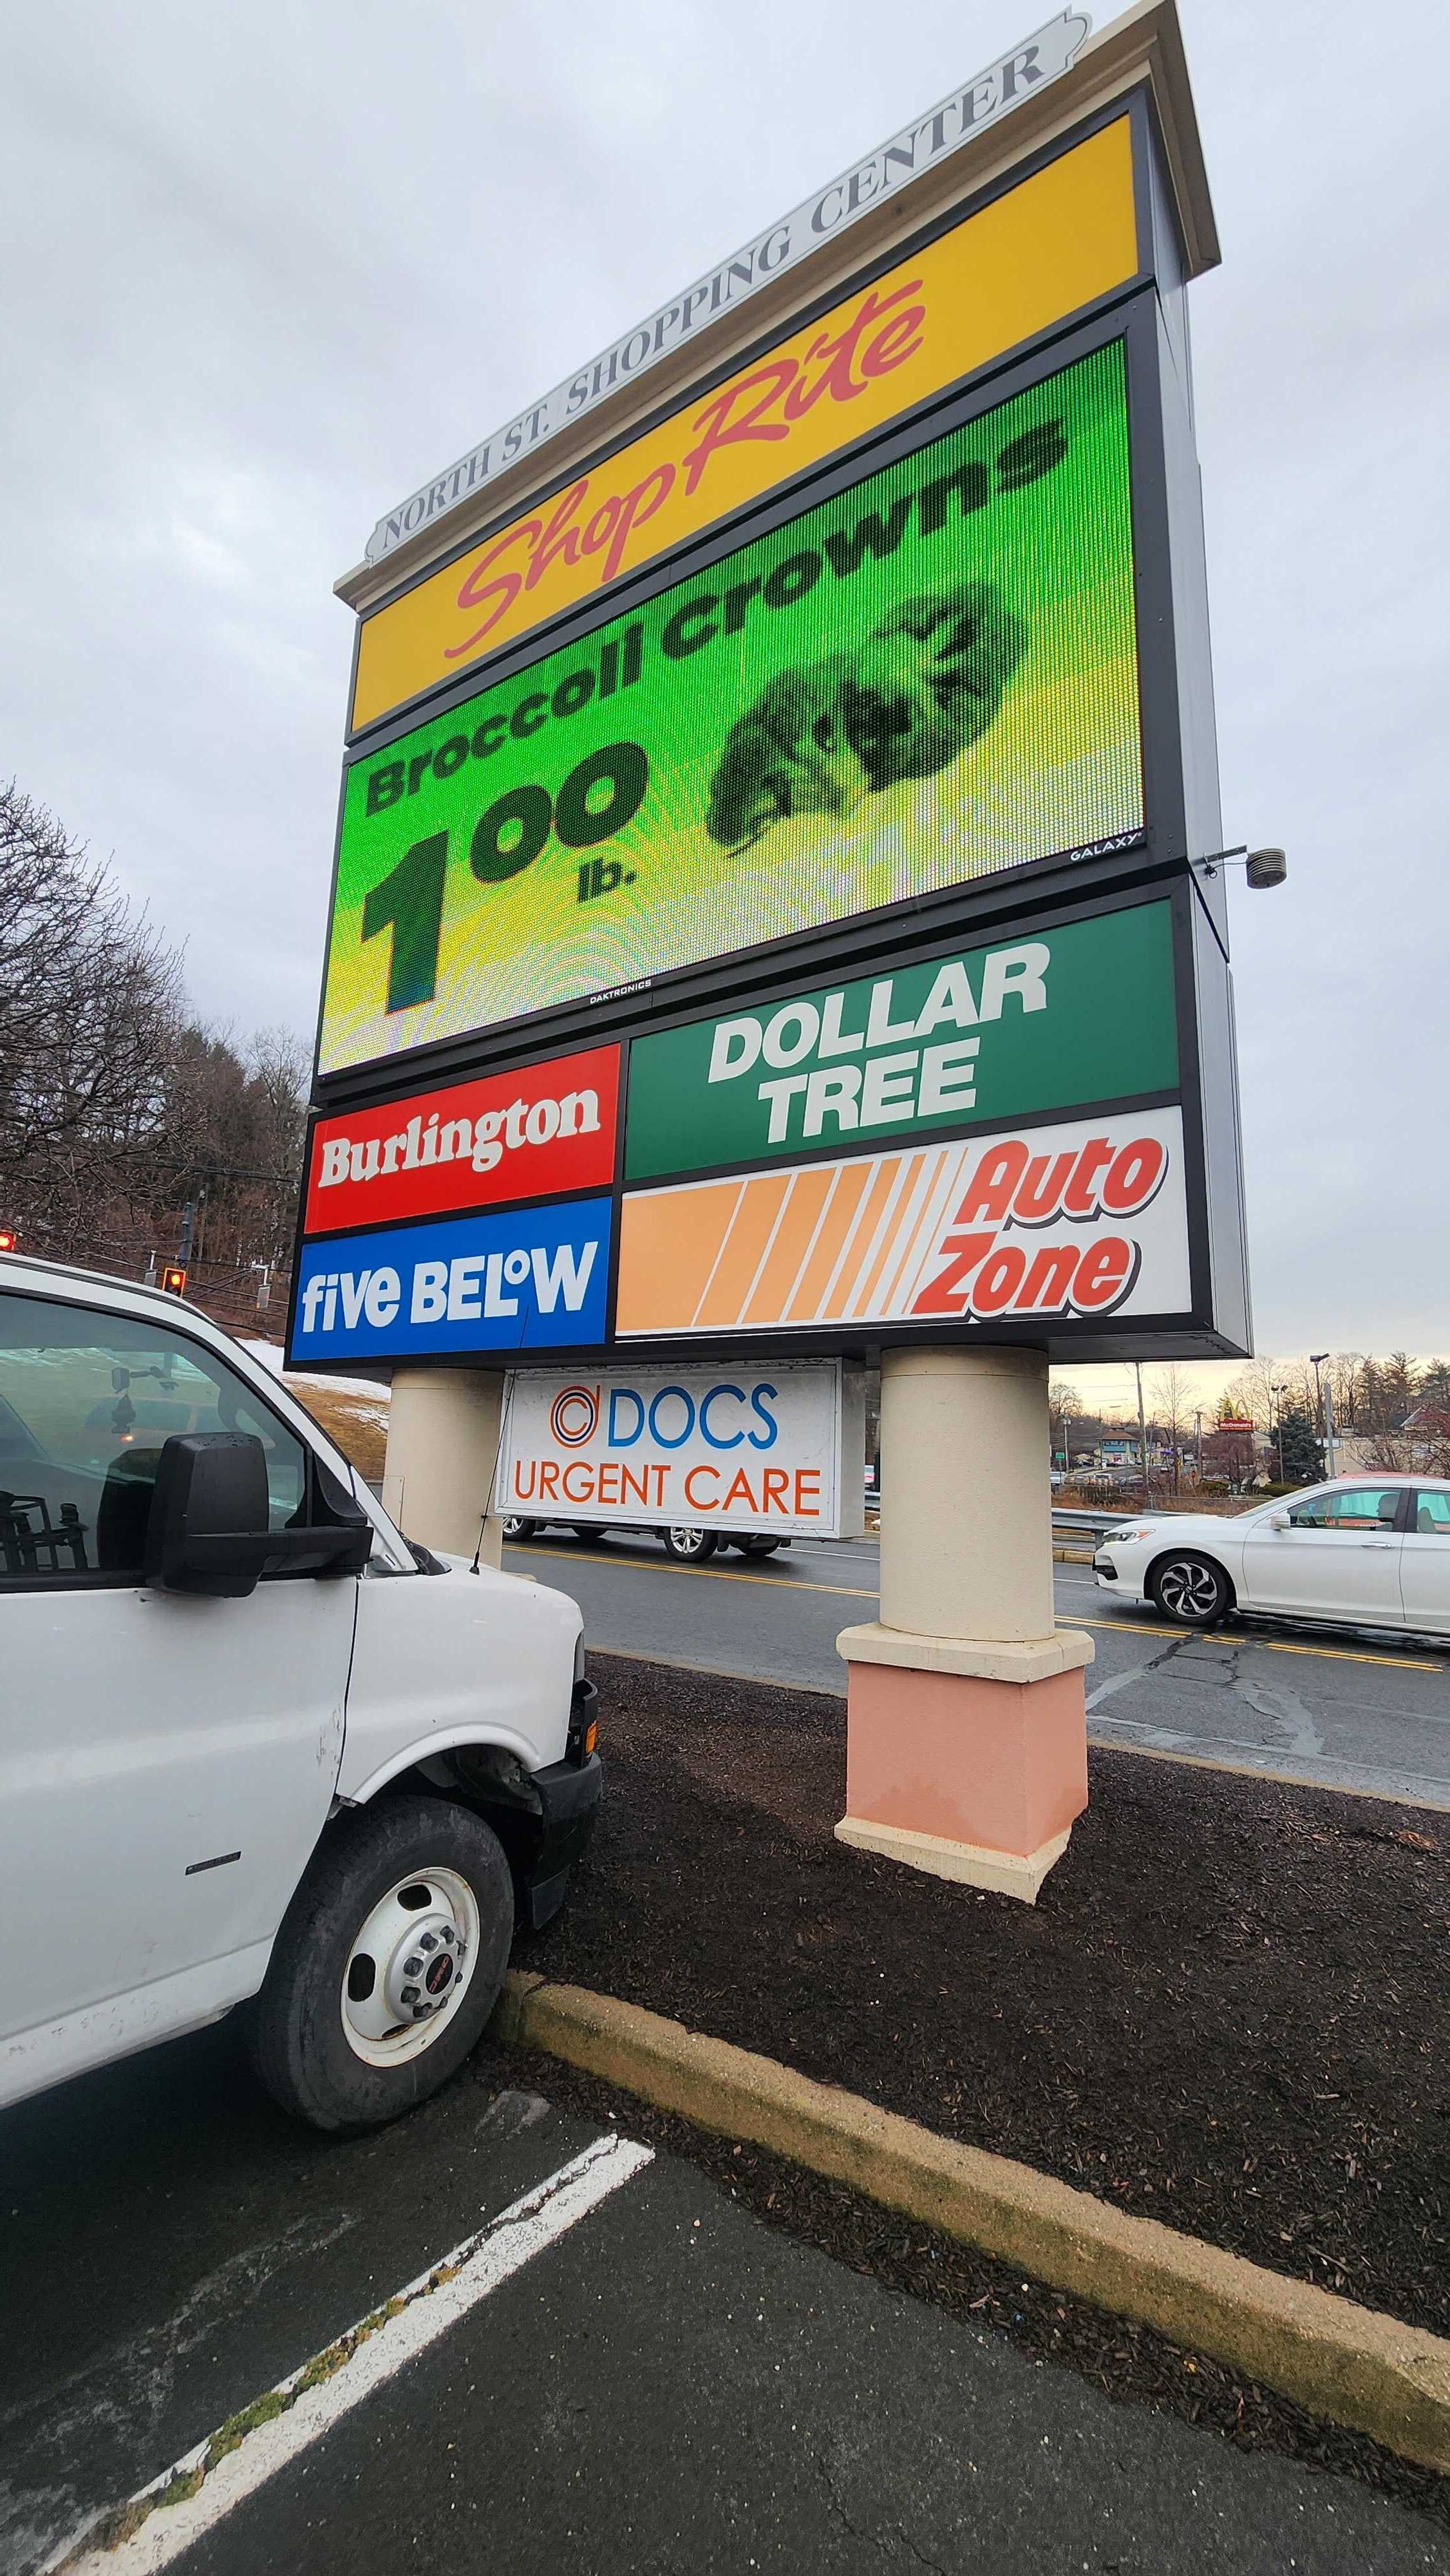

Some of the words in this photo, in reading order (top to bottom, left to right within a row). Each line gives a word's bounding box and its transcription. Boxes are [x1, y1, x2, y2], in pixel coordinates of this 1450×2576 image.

[383, 444, 491, 549] NORTH
[502, 404, 549, 461] ST.
[566, 225, 792, 415] SHOPPING
[811, 46, 1045, 232] CENTER
[365, 623, 642, 817] Broccoli
[661, 416, 1066, 661] Crowns
[578, 857, 636, 902] lb.
[1070, 832, 1138, 860] GALAXY
[590, 980, 652, 1004] DAKTRONICS
[708, 942, 1050, 1083] DOLLAR
[757, 1036, 980, 1144] TREE
[318, 1090, 600, 1188] Burlington
[952, 1137, 1169, 1231] Auto
[302, 1267, 401, 1332] five
[410, 1241, 599, 1324] BELOW
[910, 1231, 1142, 1320] Zone
[608, 1383, 778, 1450] DOCS
[514, 1460, 671, 1507] URGENT
[684, 1464, 820, 1516] CARE
